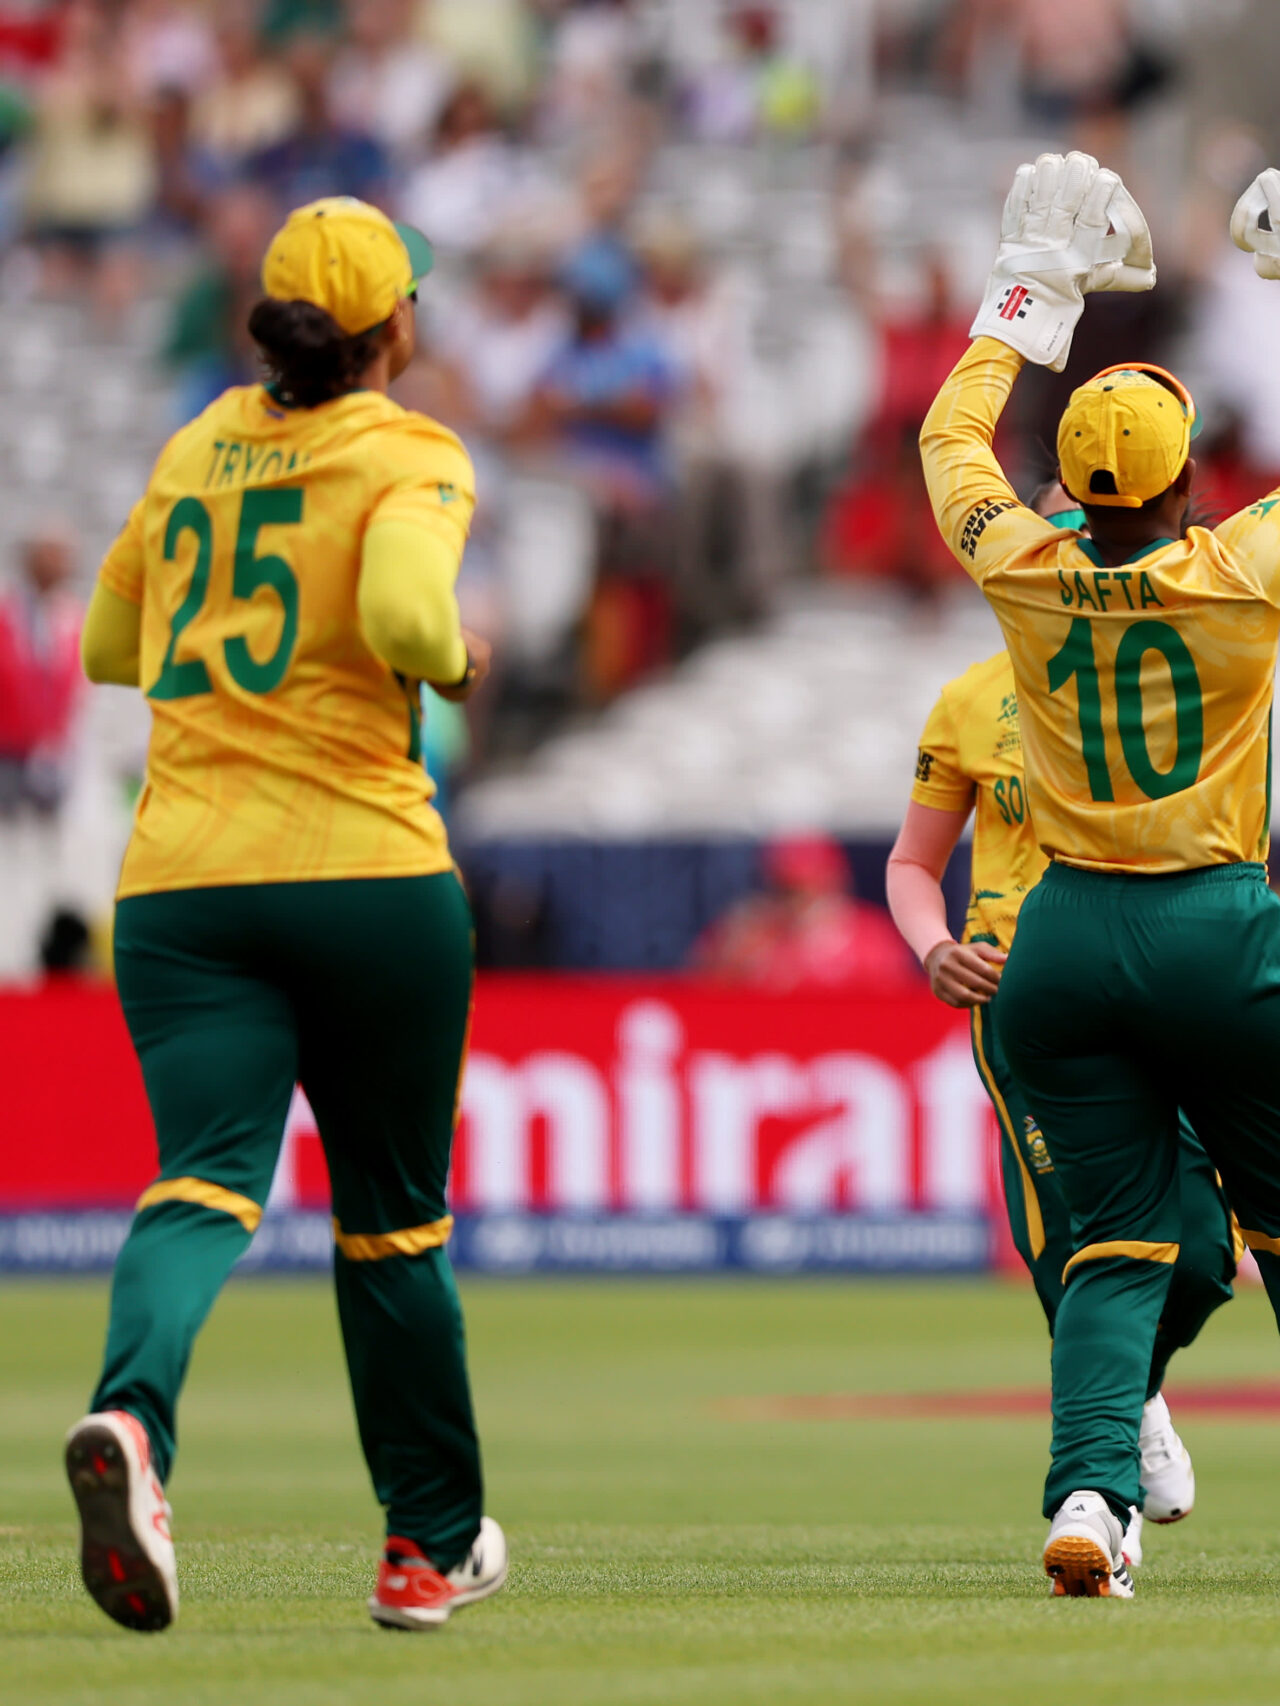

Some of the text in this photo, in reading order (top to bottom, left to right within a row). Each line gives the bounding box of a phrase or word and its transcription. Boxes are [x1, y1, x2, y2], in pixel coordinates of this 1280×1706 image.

[968, 502, 1018, 560] ADAR
[1058, 570, 1165, 612] JAFTA
[146, 487, 304, 700] 25
[1047, 617, 1204, 802] 10
